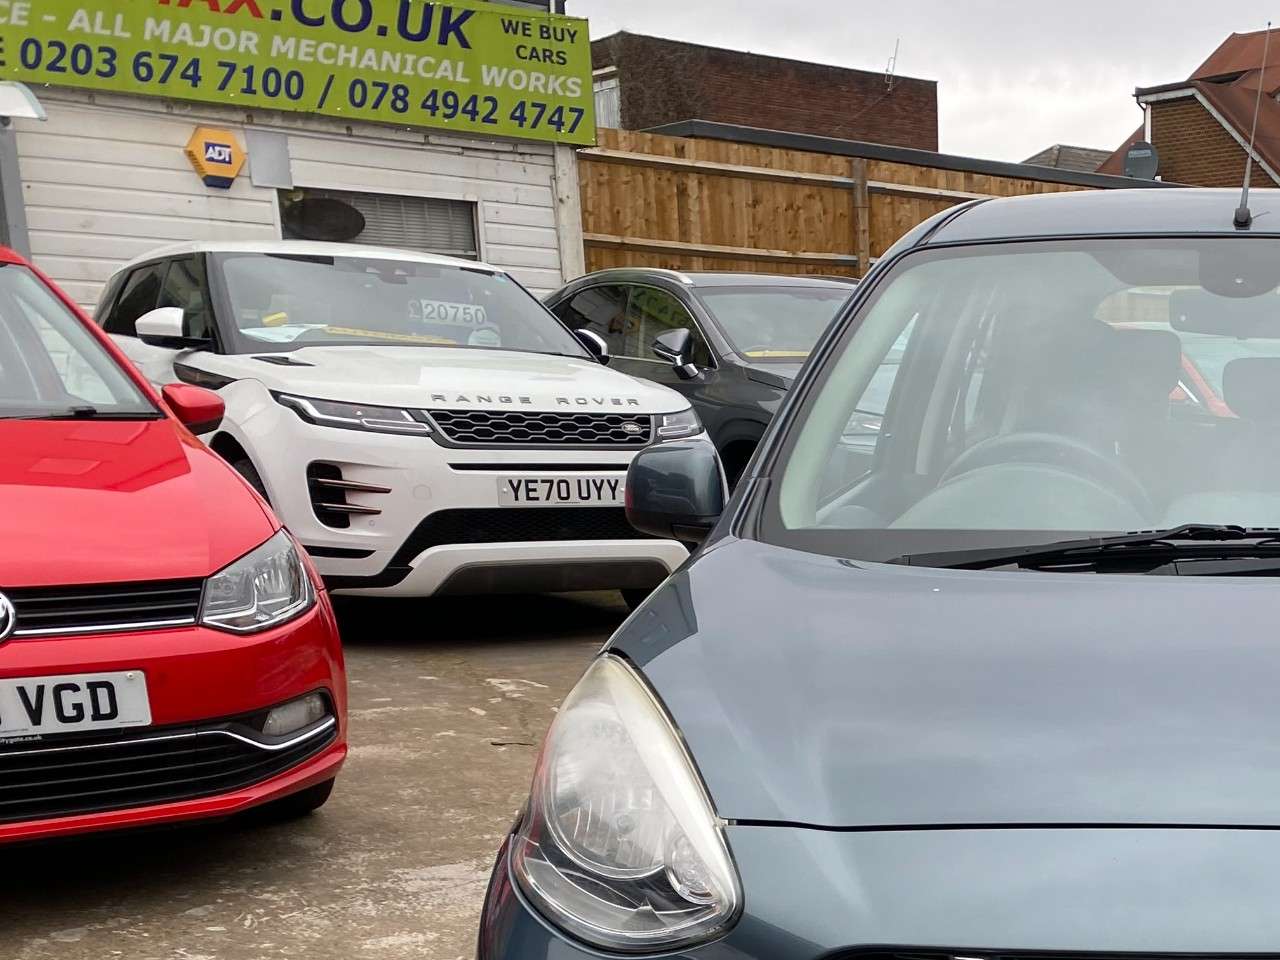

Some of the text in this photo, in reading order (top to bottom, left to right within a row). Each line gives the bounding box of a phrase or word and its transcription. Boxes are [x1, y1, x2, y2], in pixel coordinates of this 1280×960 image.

[501, 18, 578, 44] WE BUY
[67, 8, 132, 39] ALL
[144, 17, 259, 55] MAJOR
[270, 34, 470, 84] MECHANICAL
[480, 64, 583, 98] WORKS
[515, 44, 567, 66] CARS
[20, 37, 118, 78] 0203
[132, 50, 202, 88] 674
[217, 60, 305, 101] 7100
[317, 73, 335, 109] /
[348, 78, 410, 114] 078
[420, 88, 499, 125] 4942
[509, 100, 585, 134] 4747
[206, 146, 231, 162] ADT
[431, 394, 640, 406] RANGE ROVER
[508, 479, 620, 502] YE70 UYY
[16, 681, 118, 727] VGD
